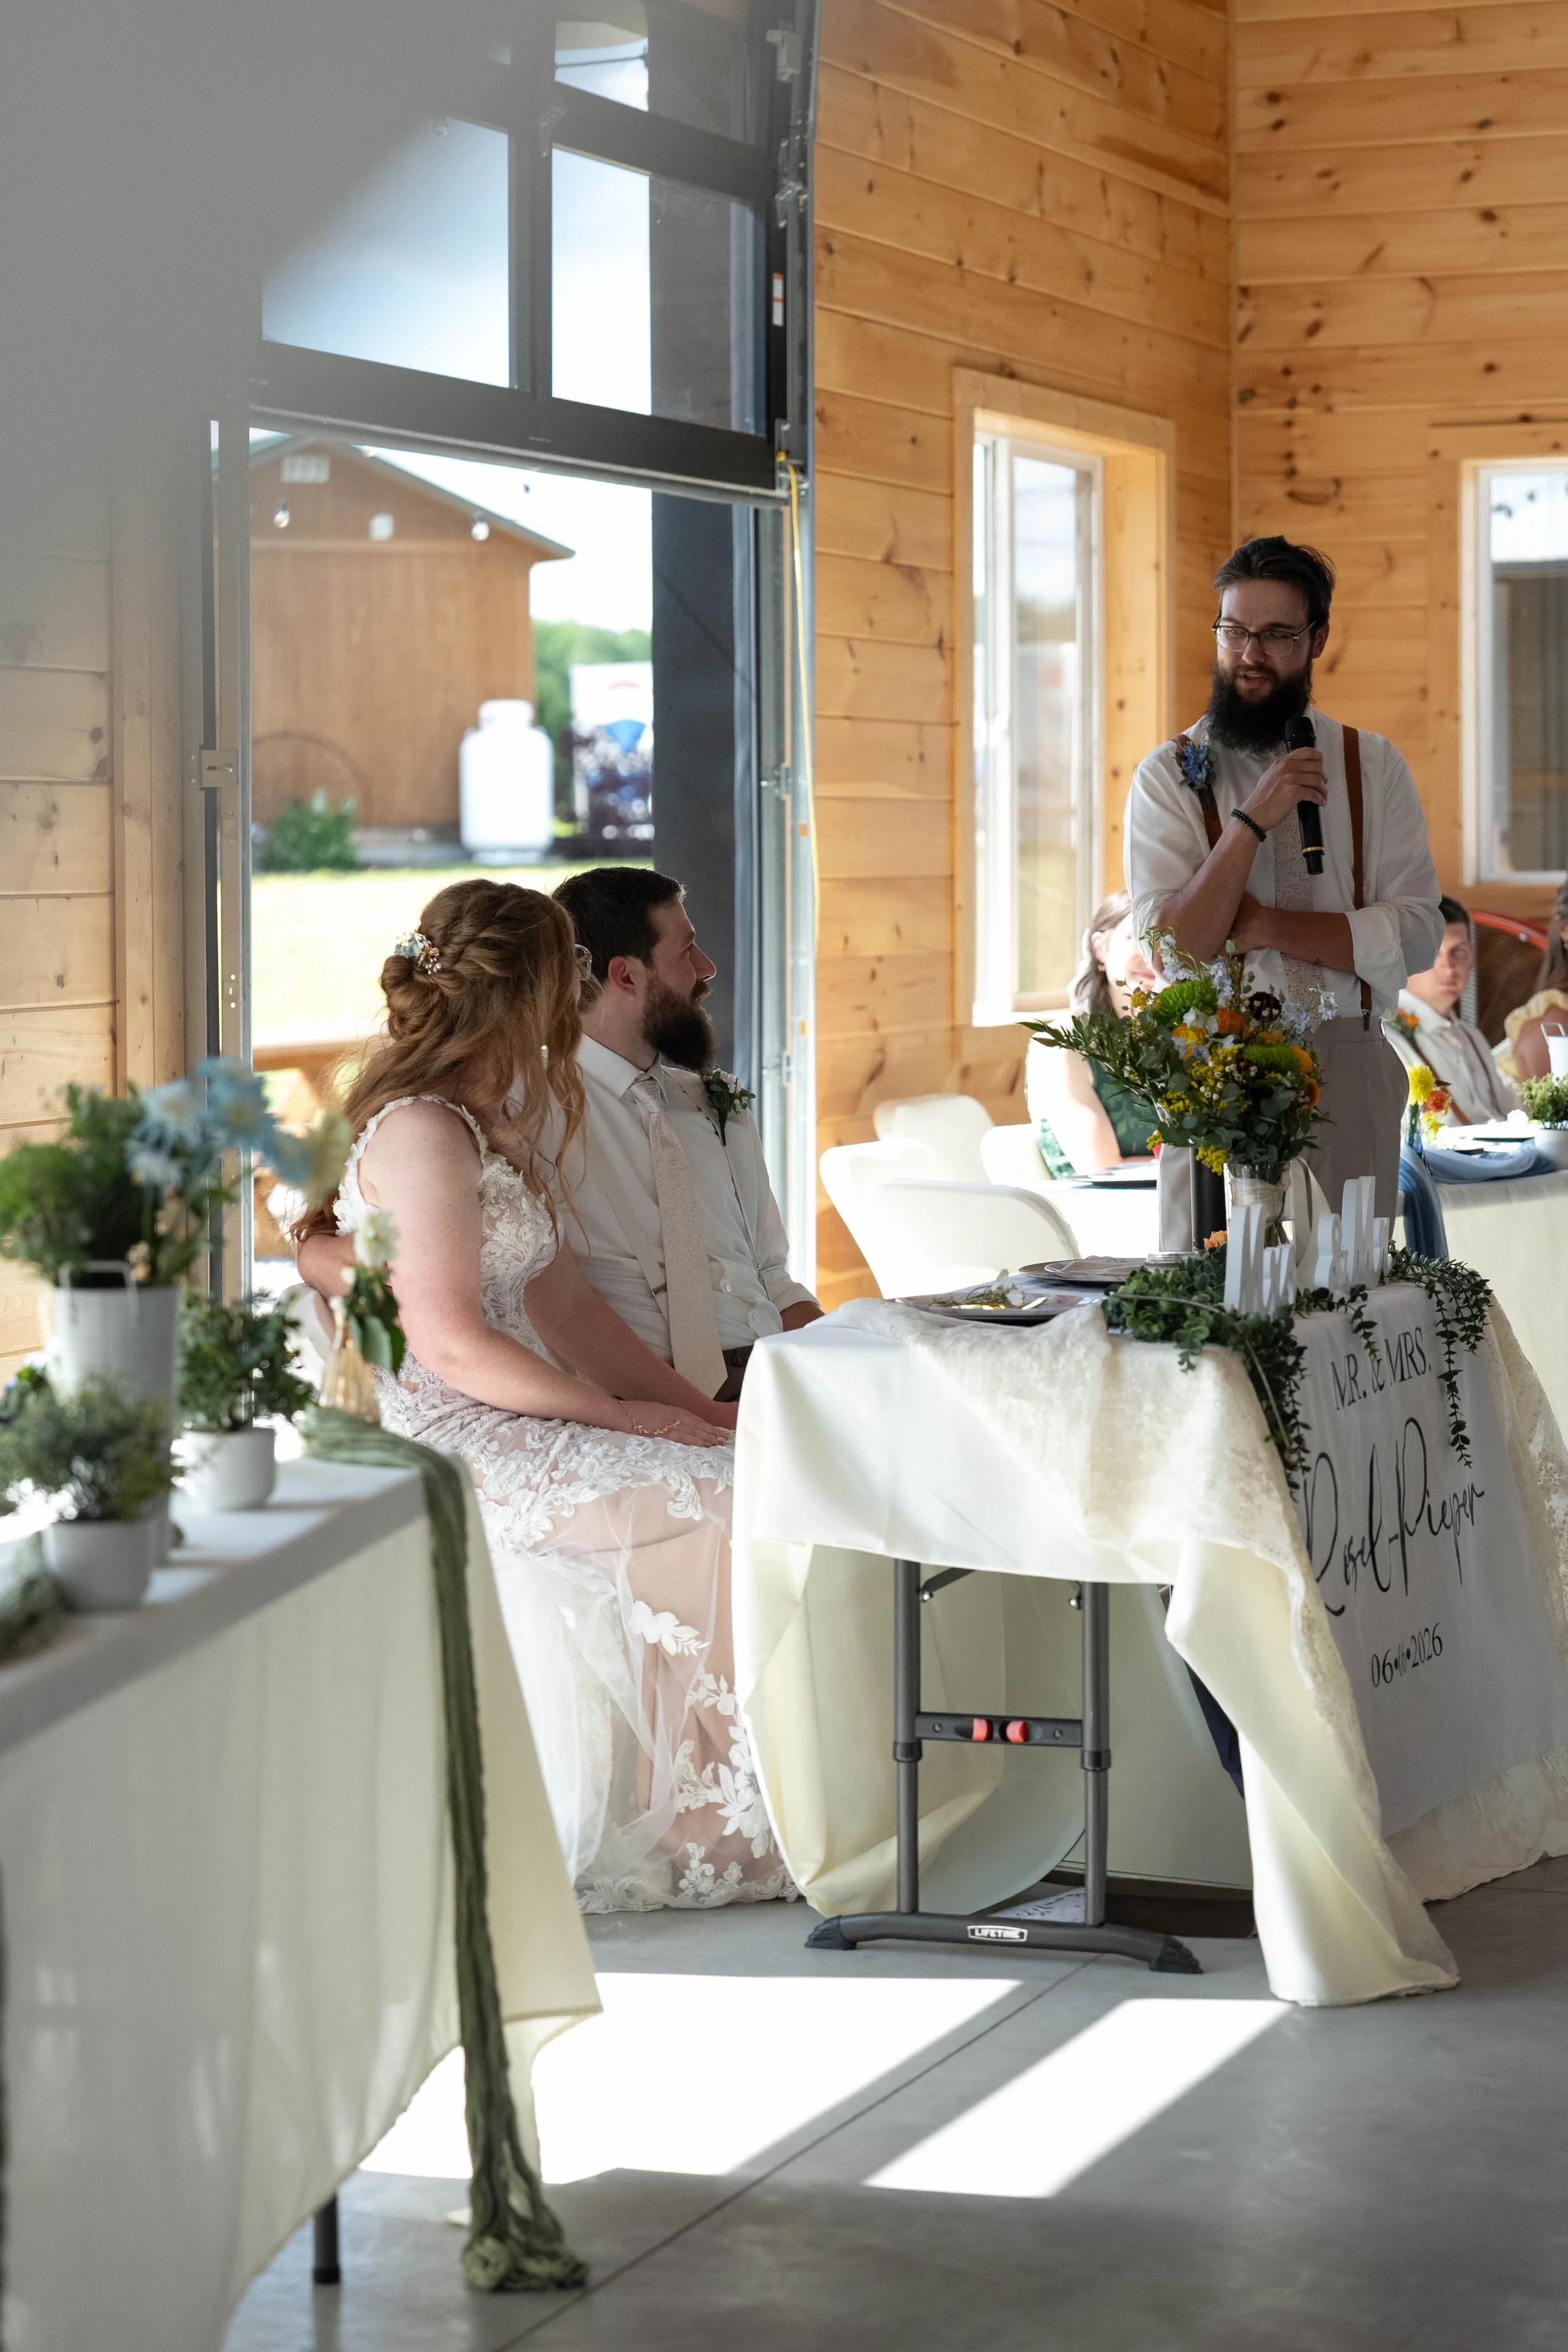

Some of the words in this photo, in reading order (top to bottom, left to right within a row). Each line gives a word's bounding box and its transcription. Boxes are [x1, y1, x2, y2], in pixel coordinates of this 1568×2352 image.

[1331, 1353, 1367, 1411] MR.
[1370, 1355, 1385, 1394] &
[1384, 1326, 1432, 1385] MRS.
[975, 1929, 1020, 1939] LIFETIME
